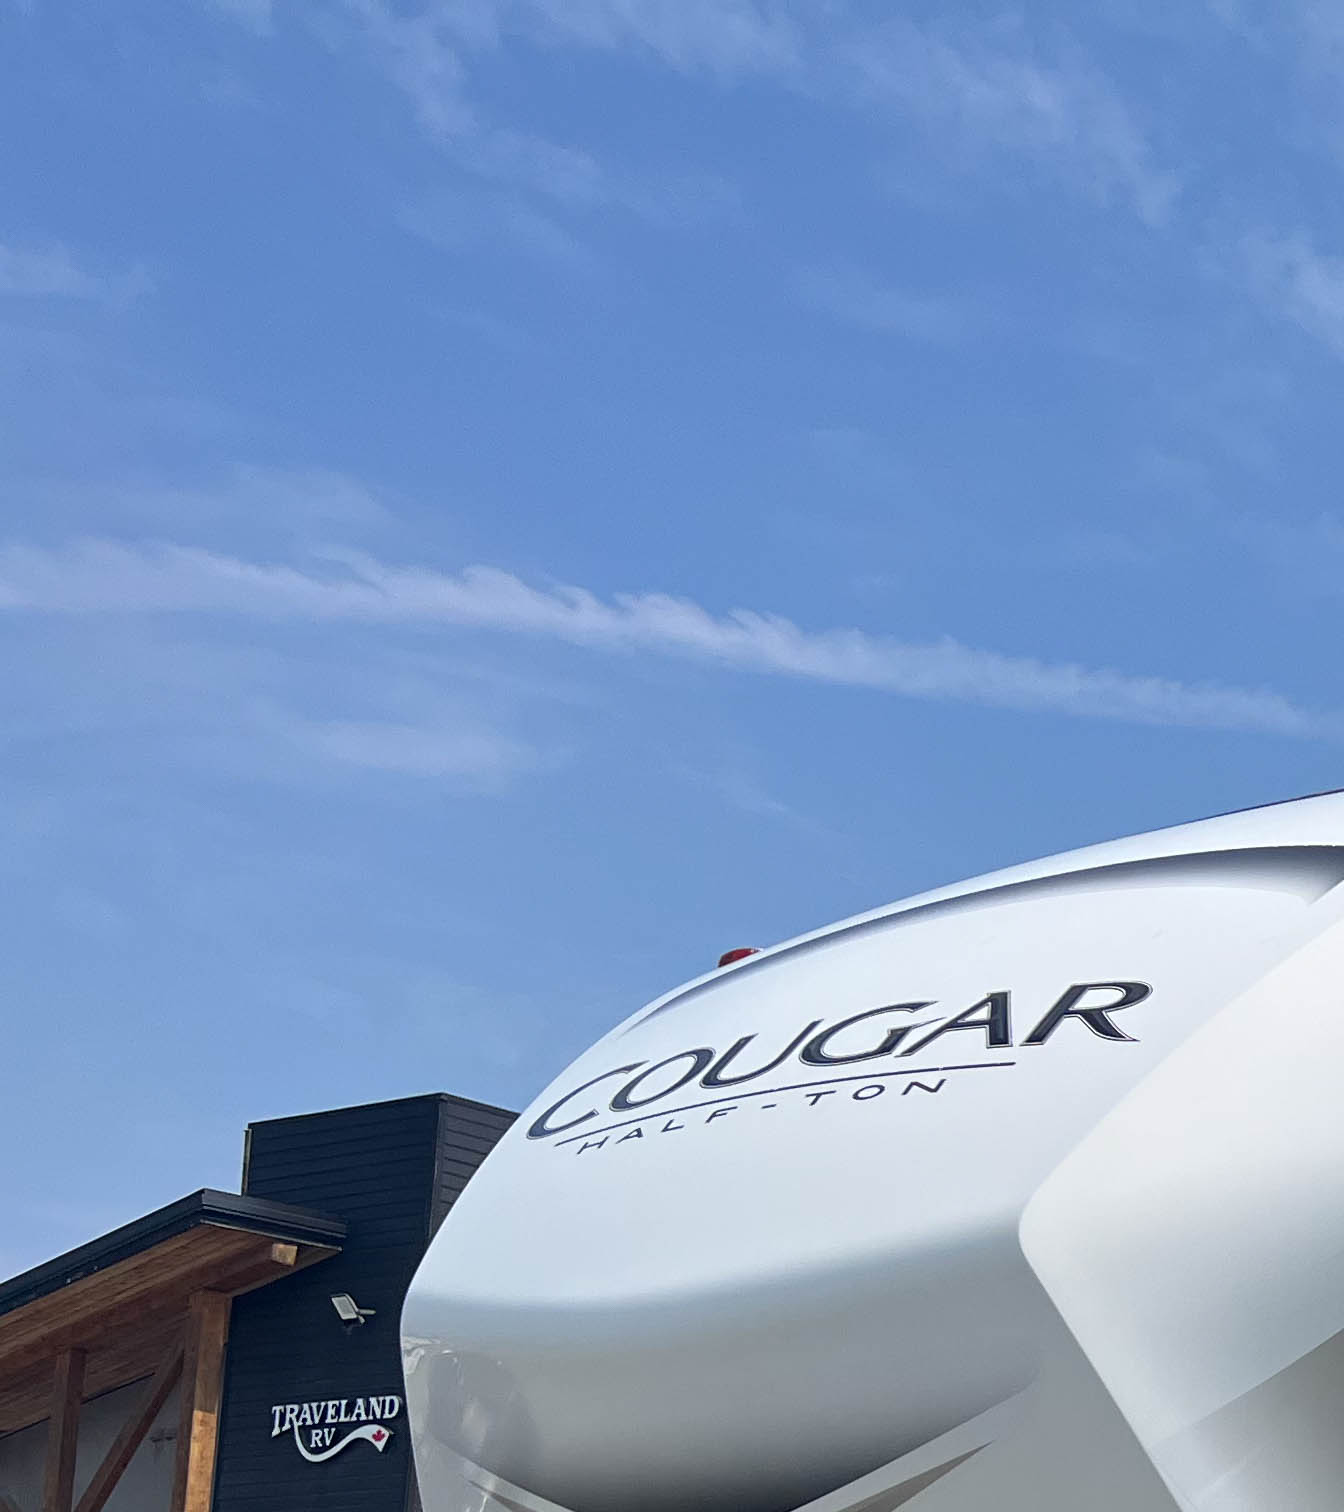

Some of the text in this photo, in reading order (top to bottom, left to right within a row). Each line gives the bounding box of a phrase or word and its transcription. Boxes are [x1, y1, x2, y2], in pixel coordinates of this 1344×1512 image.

[526, 981, 1153, 1140] COUGAR
[271, 1395, 400, 1438] TRAVELAND
[310, 1428, 336, 1447] RV
